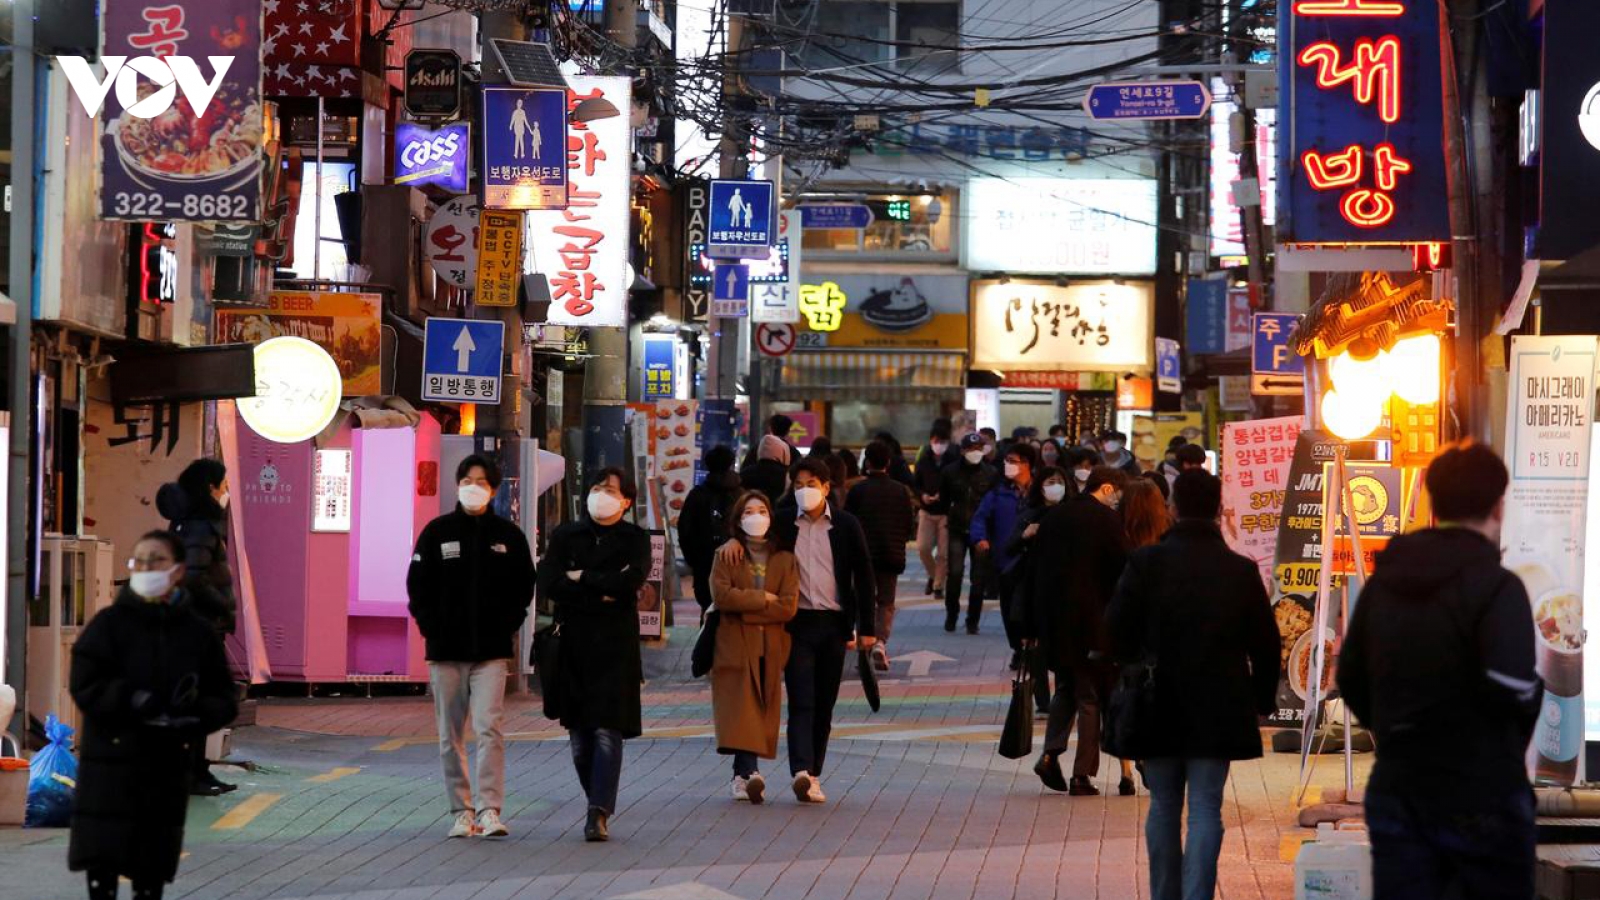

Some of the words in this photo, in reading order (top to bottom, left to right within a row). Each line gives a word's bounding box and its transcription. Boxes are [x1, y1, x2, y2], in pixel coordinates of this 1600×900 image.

[410, 68, 455, 86] Asahi
[490, 166, 561, 181] 보행자우선도로
[115, 192, 247, 217] 322-8682
[283, 296, 314, 310] BEER
[430, 378, 495, 397] 일방통행
[1527, 377, 1585, 399] 마시그레이
[1526, 405, 1585, 427] 아메리카노
